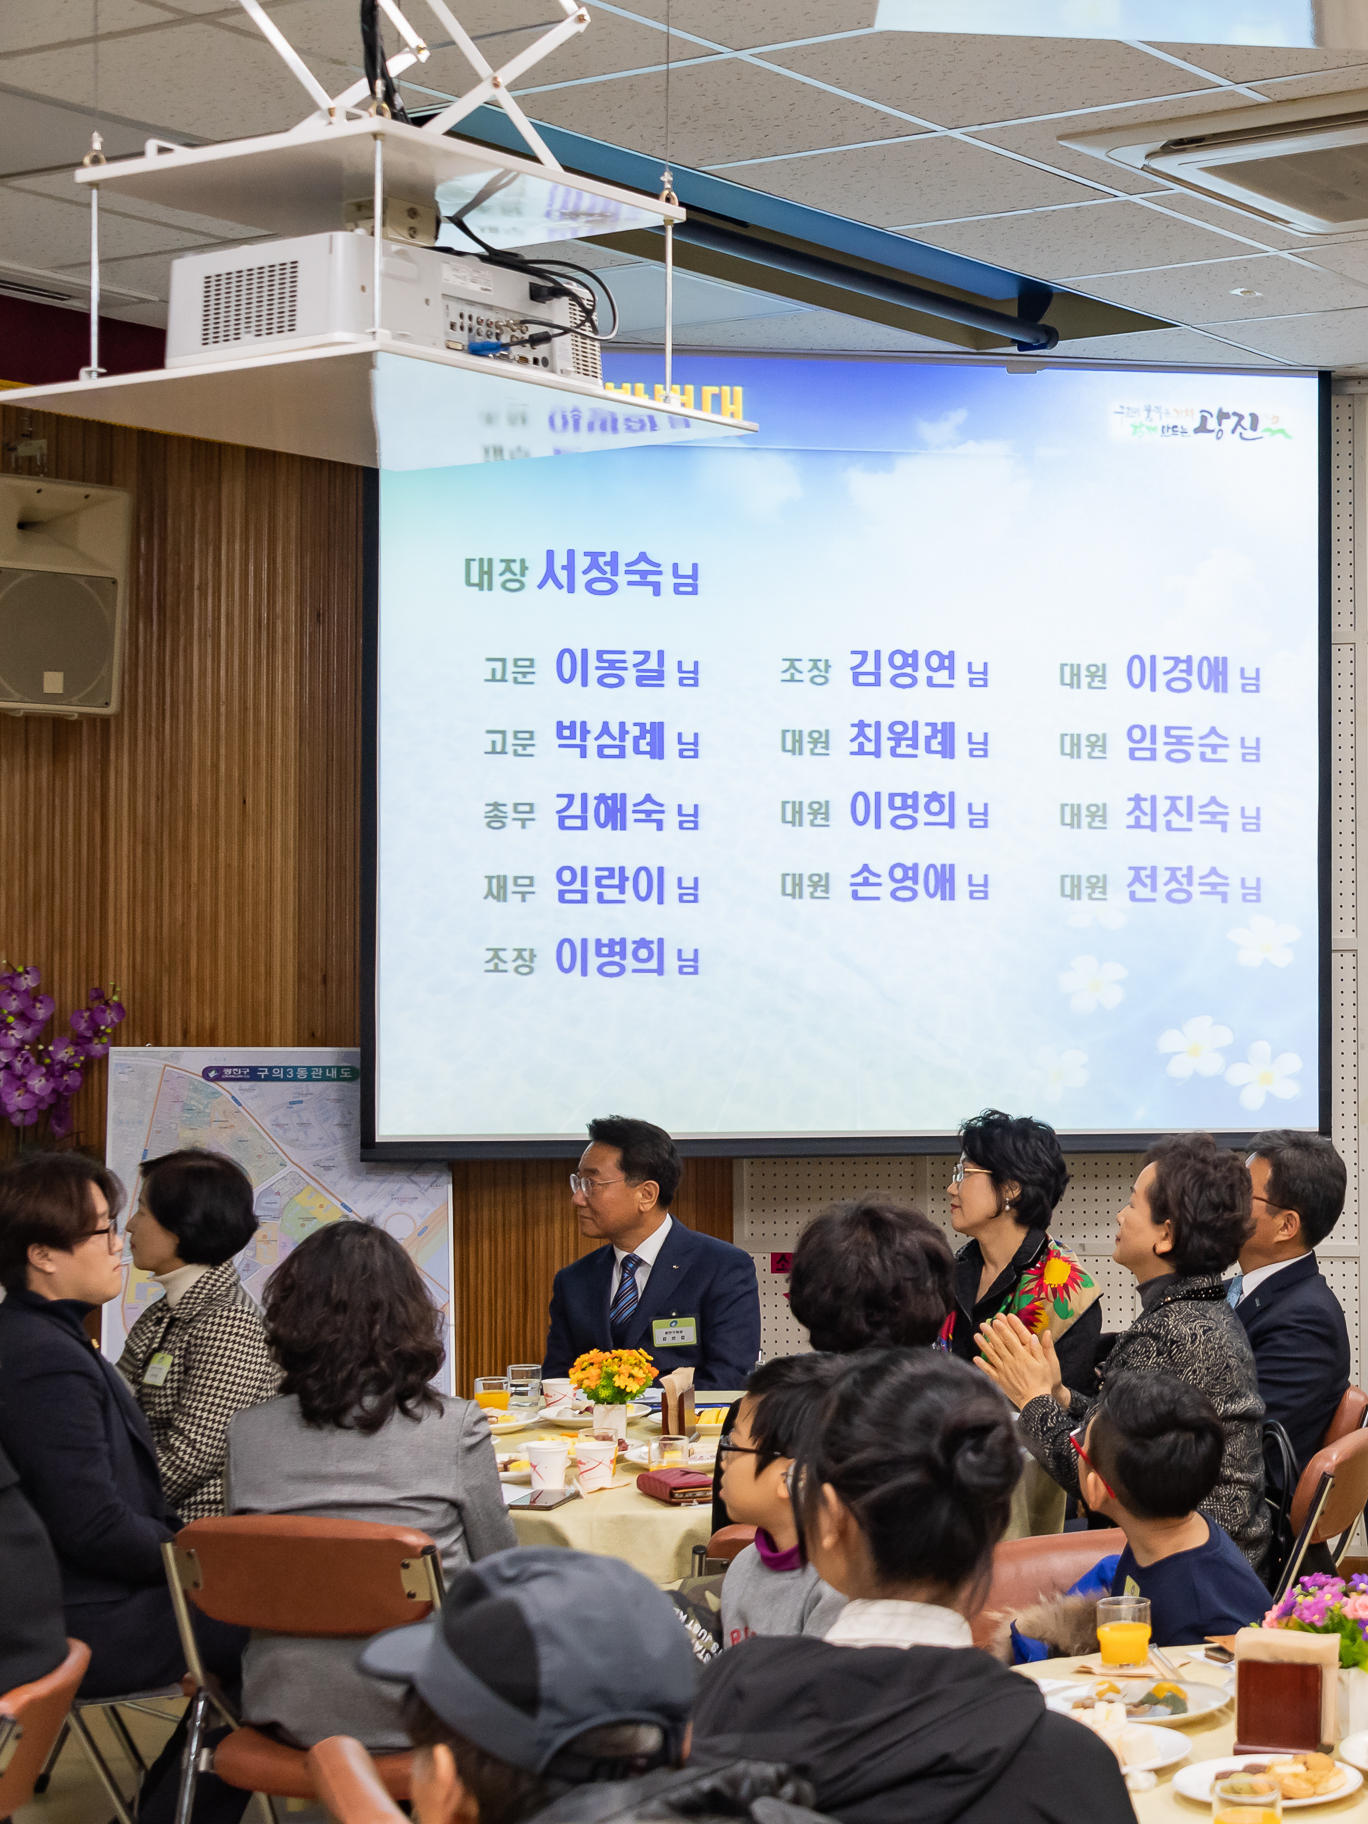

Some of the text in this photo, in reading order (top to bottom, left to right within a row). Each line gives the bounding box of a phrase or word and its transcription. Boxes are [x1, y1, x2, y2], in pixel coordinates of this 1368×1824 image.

[1193, 407, 1264, 441] 광진
[465, 557, 529, 593] 대장
[537, 549, 663, 597] 서정숙
[484, 657, 536, 685] 고문
[556, 648, 665, 689] 이동길
[781, 658, 832, 686] 조장
[850, 649, 955, 689] 김영연
[1060, 663, 1107, 690] 대원
[1127, 654, 1228, 694] 이경애
[484, 730, 536, 757] 고문
[556, 720, 664, 760] 박삼례
[781, 729, 830, 756] 대원
[849, 719, 955, 760] 최원례
[1060, 733, 1107, 759] 대원
[1127, 724, 1229, 763] 임동순
[484, 801, 536, 830] 총무
[556, 792, 665, 831] 김해숙
[781, 800, 830, 827] 대원
[850, 791, 955, 830] 이명희
[1060, 803, 1107, 830] 대원
[1126, 793, 1229, 833] 최진숙
[483, 875, 536, 903] 재무
[556, 865, 664, 905] 임란이
[781, 872, 830, 900] 대원
[849, 862, 955, 902] 손영애
[1060, 874, 1107, 901] 대원
[1127, 865, 1229, 904] 전정숙
[484, 948, 537, 976] 조장
[556, 937, 664, 978] 이병희
